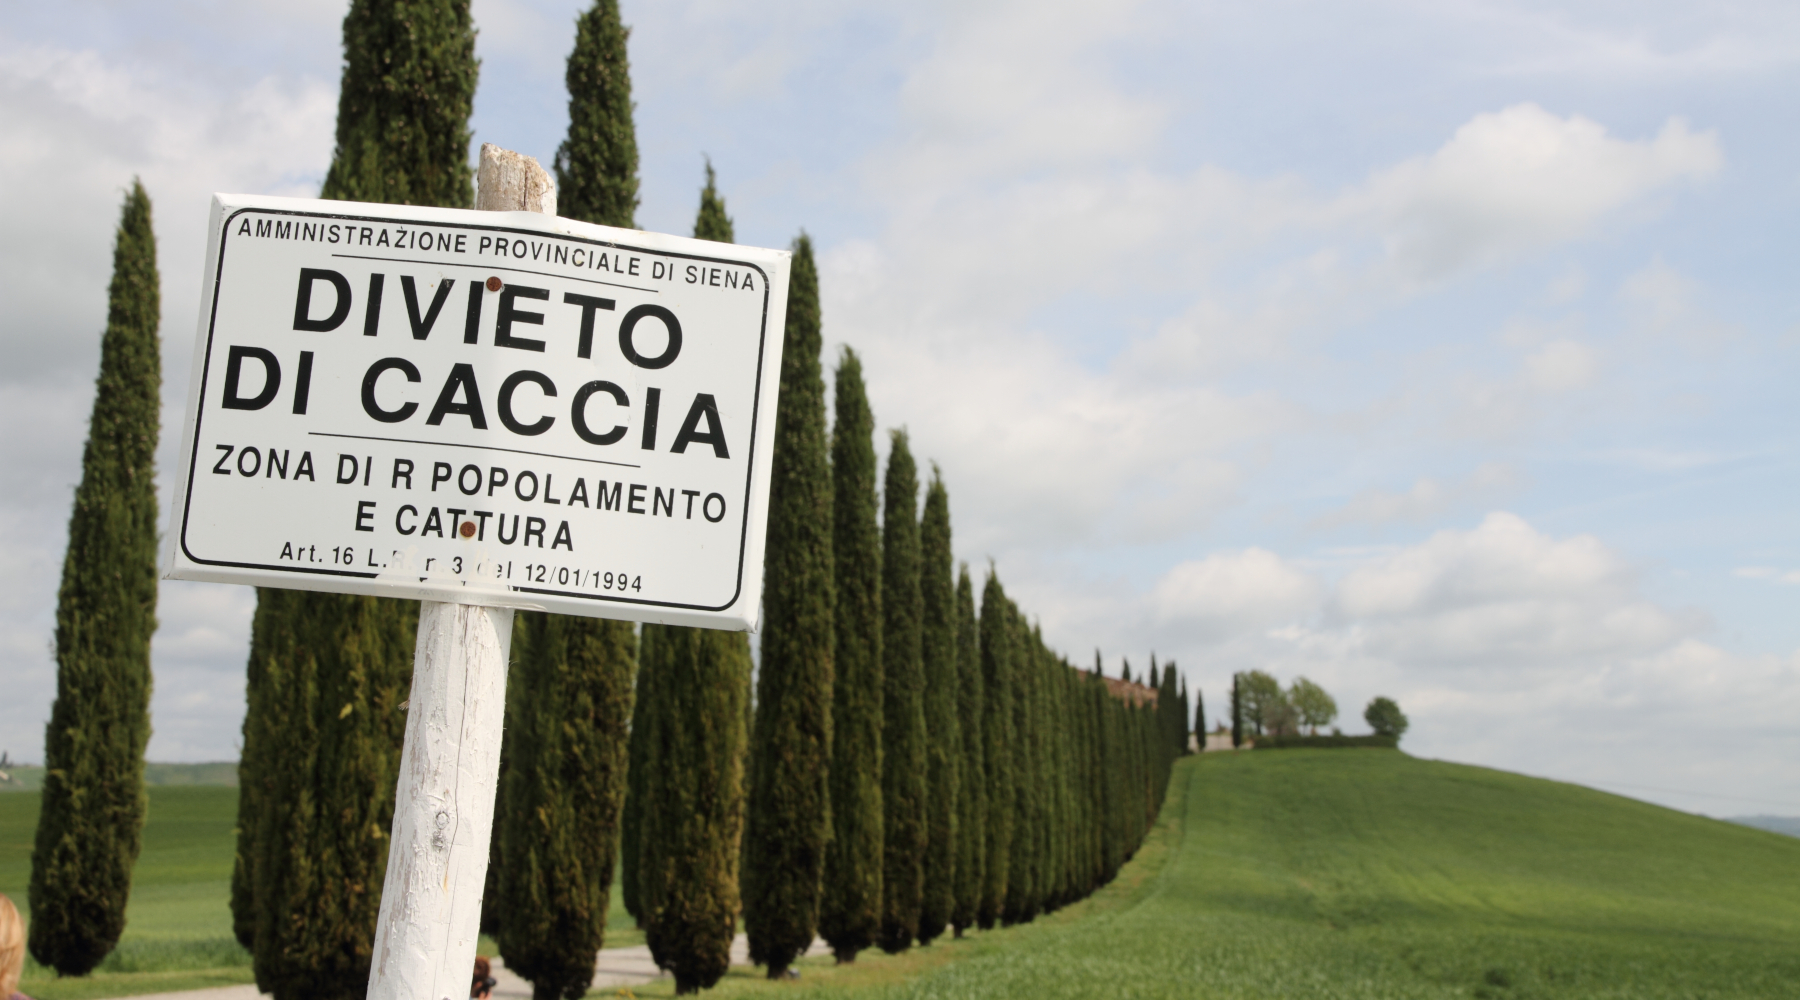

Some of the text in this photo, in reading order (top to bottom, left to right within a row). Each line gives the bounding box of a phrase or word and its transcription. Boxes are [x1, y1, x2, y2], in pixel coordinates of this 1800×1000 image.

[237, 217, 755, 291] AMMINISTRAZIONE PROVINCIALE DI SIENA
[293, 267, 683, 370] DIVIETO
[222, 345, 732, 460] DI CACCIA
[212, 443, 316, 482] ZONA
[336, 453, 373, 487] DI
[354, 500, 574, 552] E CATTURA
[279, 541, 324, 563] Art.
[332, 546, 354, 566] 16
[452, 556, 464, 575] 3
[525, 562, 643, 593] 12/01/1994
